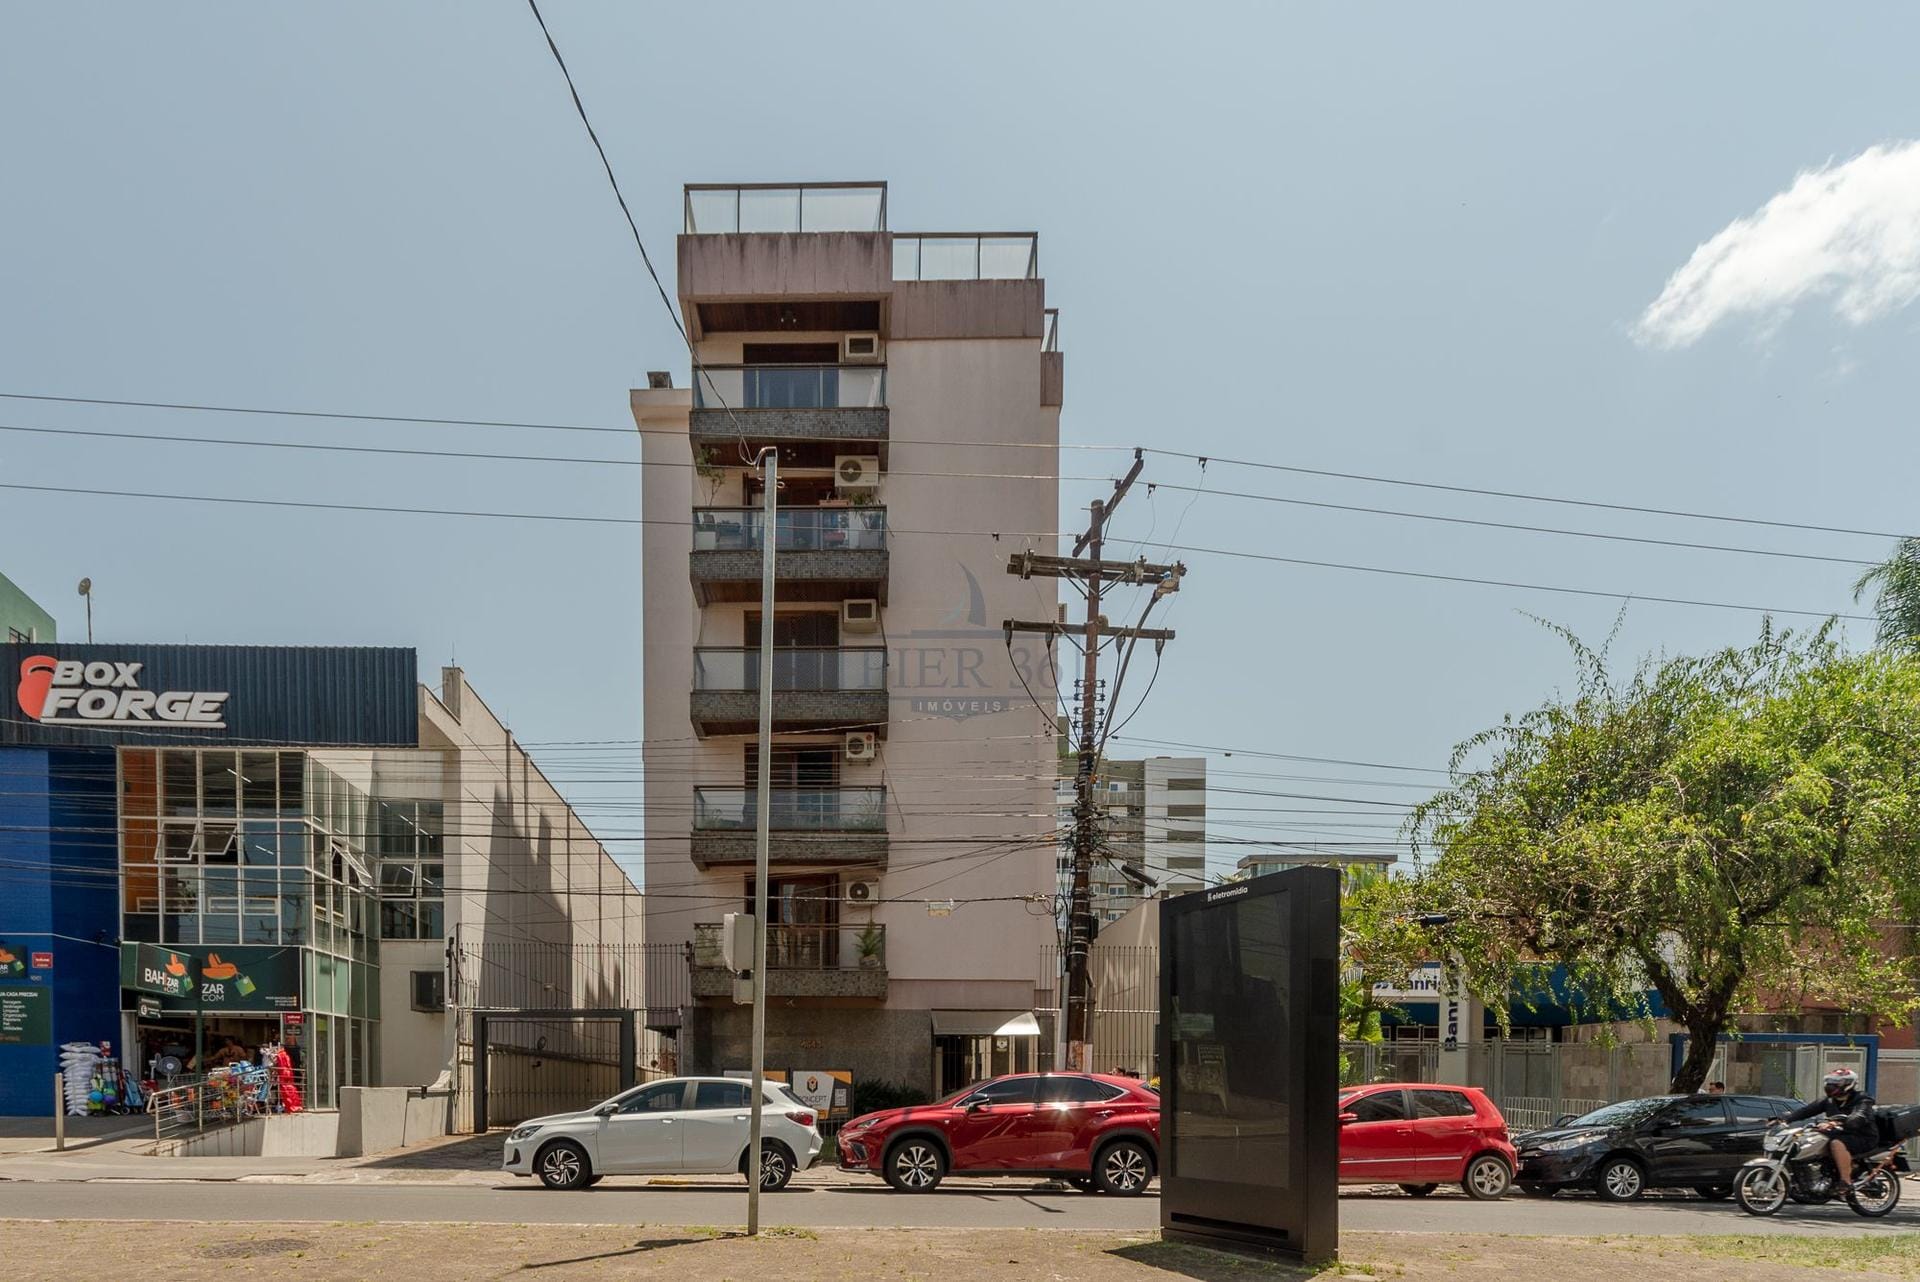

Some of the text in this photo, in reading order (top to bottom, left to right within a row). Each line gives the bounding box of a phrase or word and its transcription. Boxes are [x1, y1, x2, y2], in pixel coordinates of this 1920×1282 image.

[52, 660, 144, 688] BOX
[41, 688, 230, 721] FORGE
[201, 983, 224, 994] ZAR
[1393, 975, 1440, 991] anri
[201, 994, 225, 1002] COM
